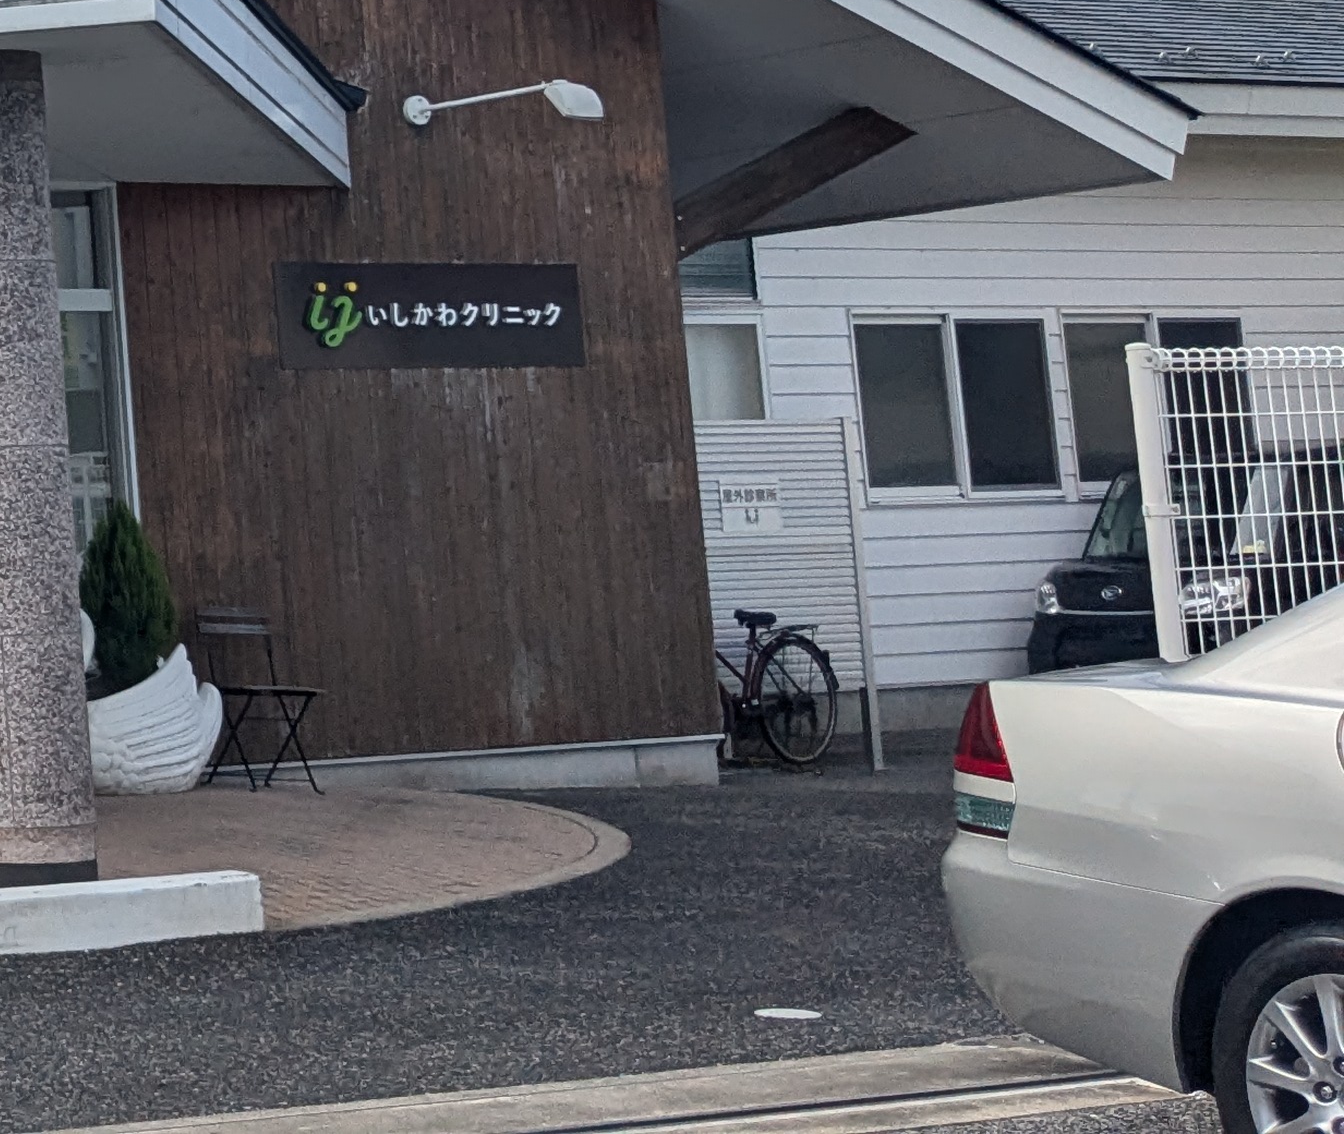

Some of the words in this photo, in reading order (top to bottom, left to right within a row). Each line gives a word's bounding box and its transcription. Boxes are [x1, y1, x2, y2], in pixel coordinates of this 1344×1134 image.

[365, 301, 562, 327] いしかわクリニック
